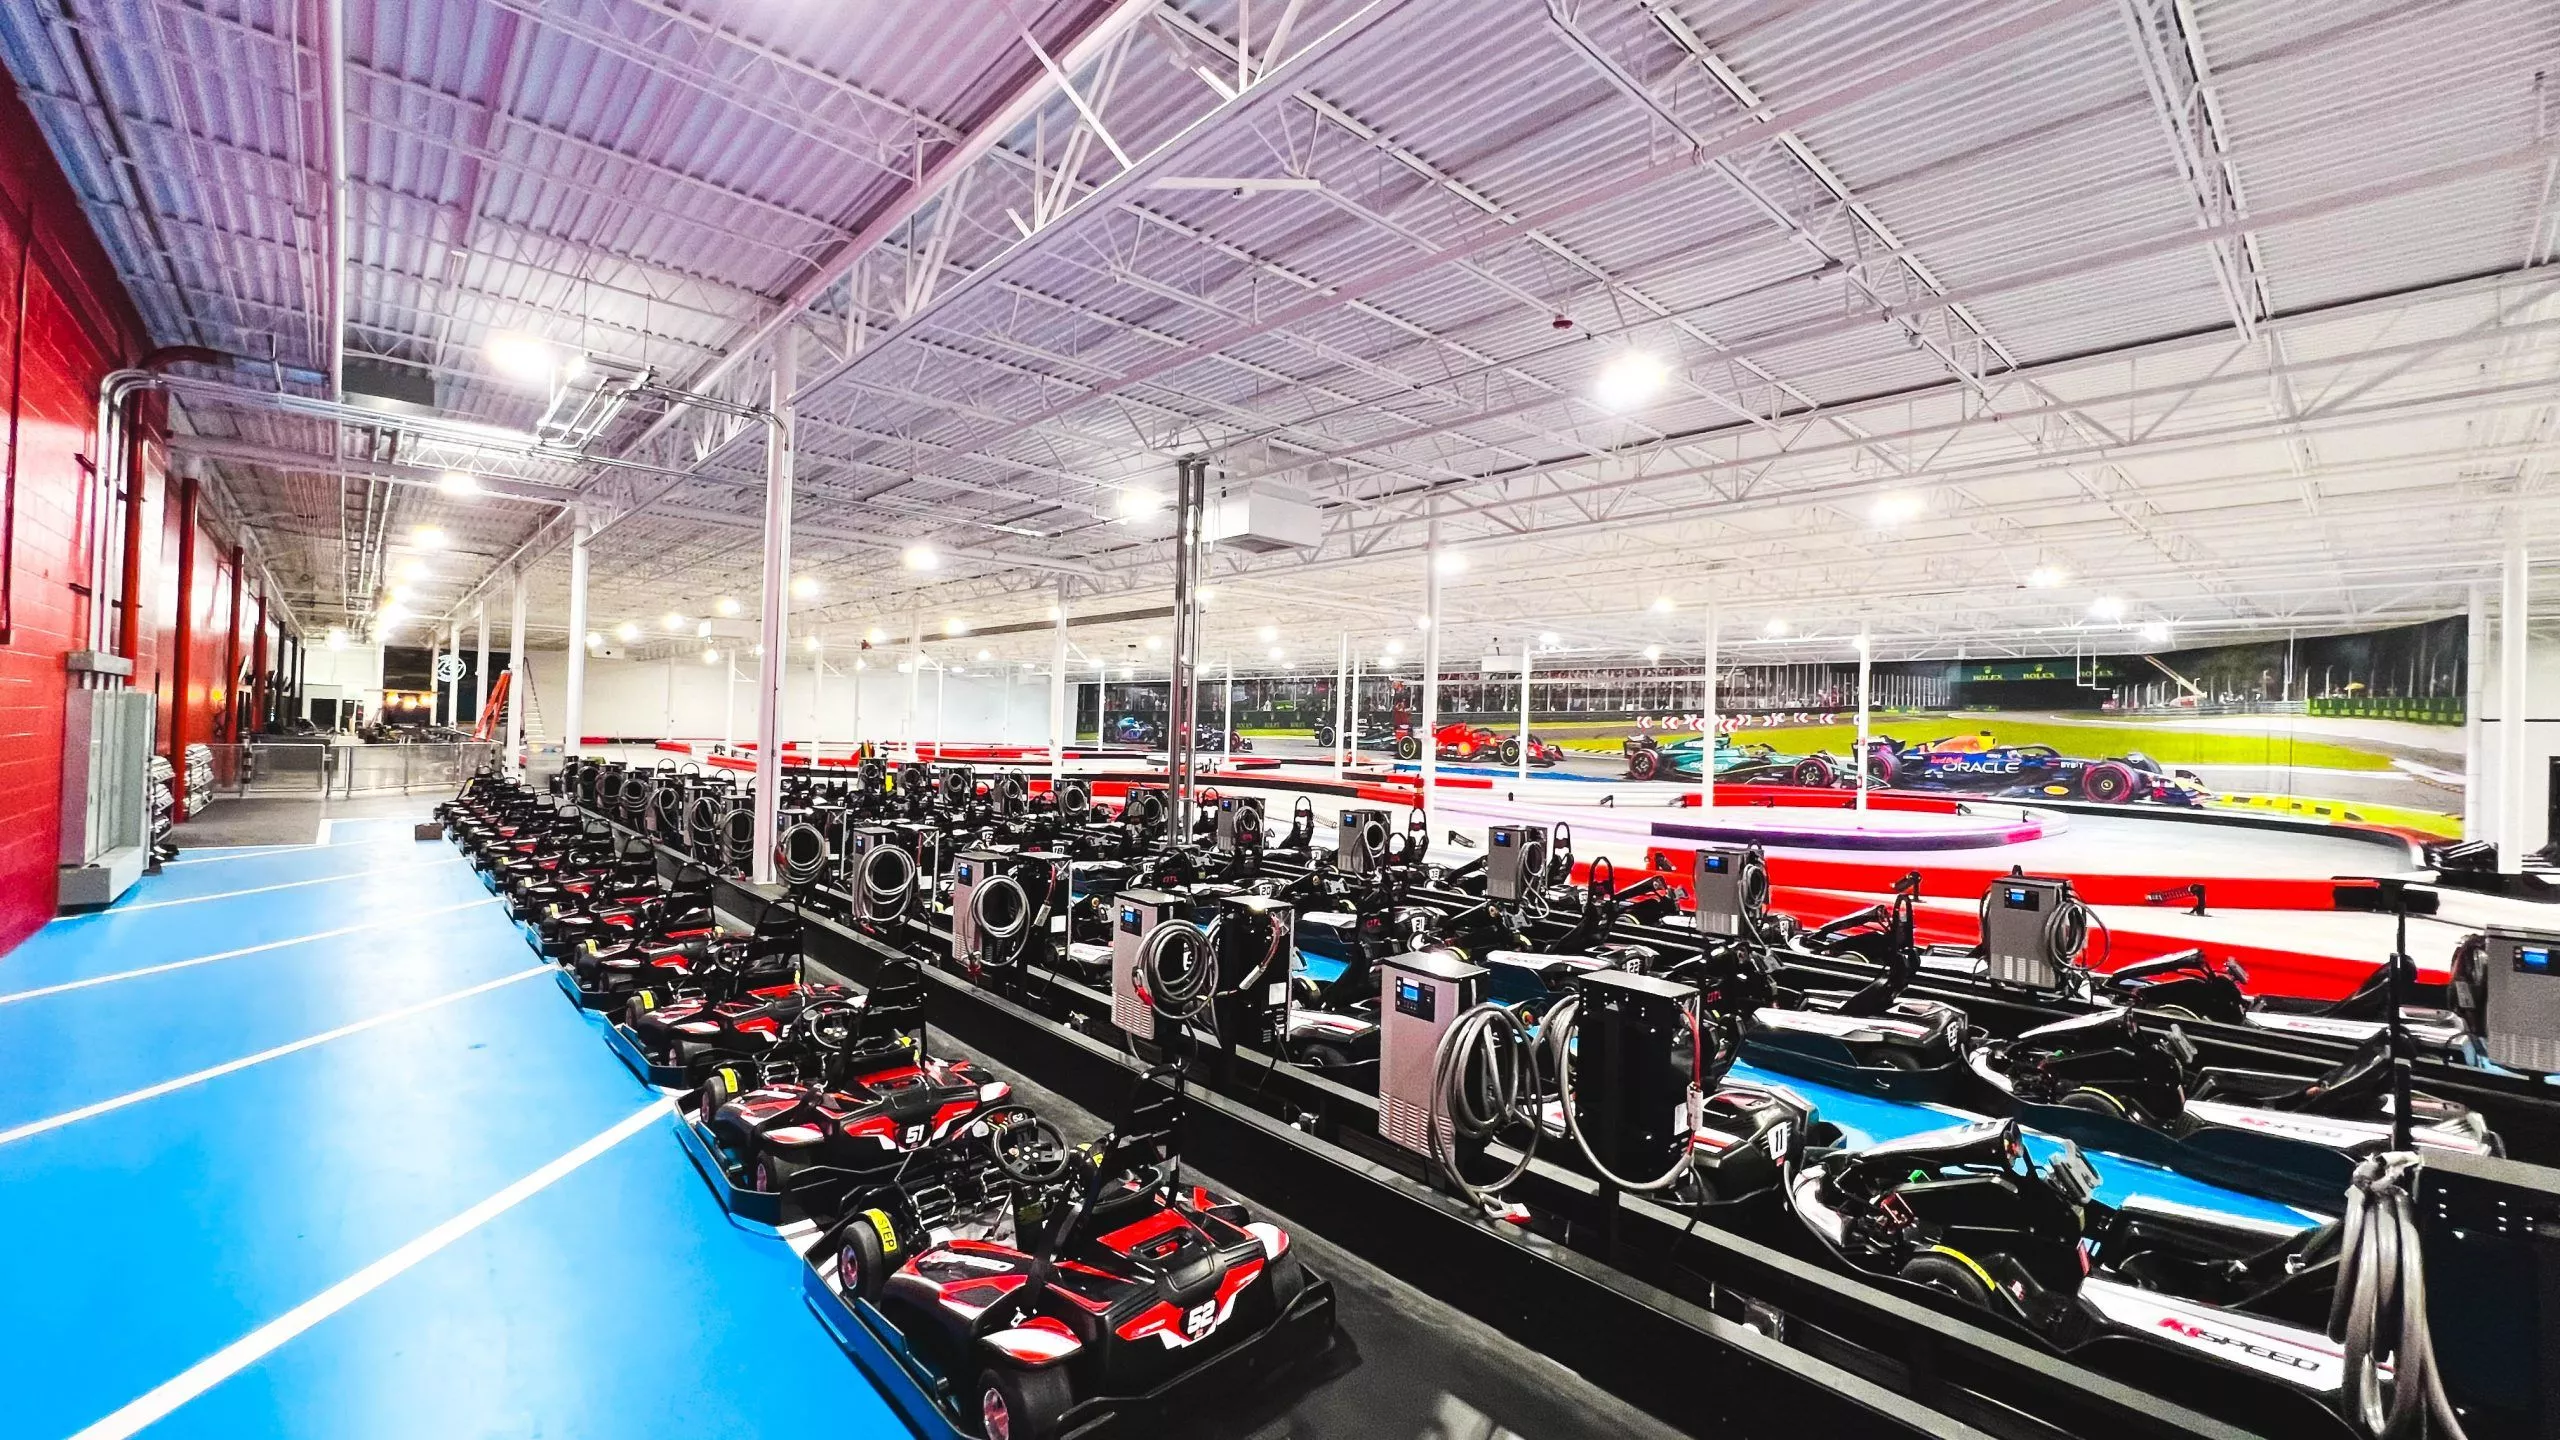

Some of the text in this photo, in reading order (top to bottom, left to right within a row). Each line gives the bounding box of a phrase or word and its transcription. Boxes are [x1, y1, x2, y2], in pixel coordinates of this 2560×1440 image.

[1973, 673, 2003, 681] ROLEX
[2022, 672, 2055, 680] ROLEX
[1942, 761, 2020, 774] ORACLE
[1260, 886, 1272, 896] 20
[905, 1123, 925, 1144] 51
[877, 1219, 895, 1248] STEP
[1186, 1299, 1216, 1335] 52
